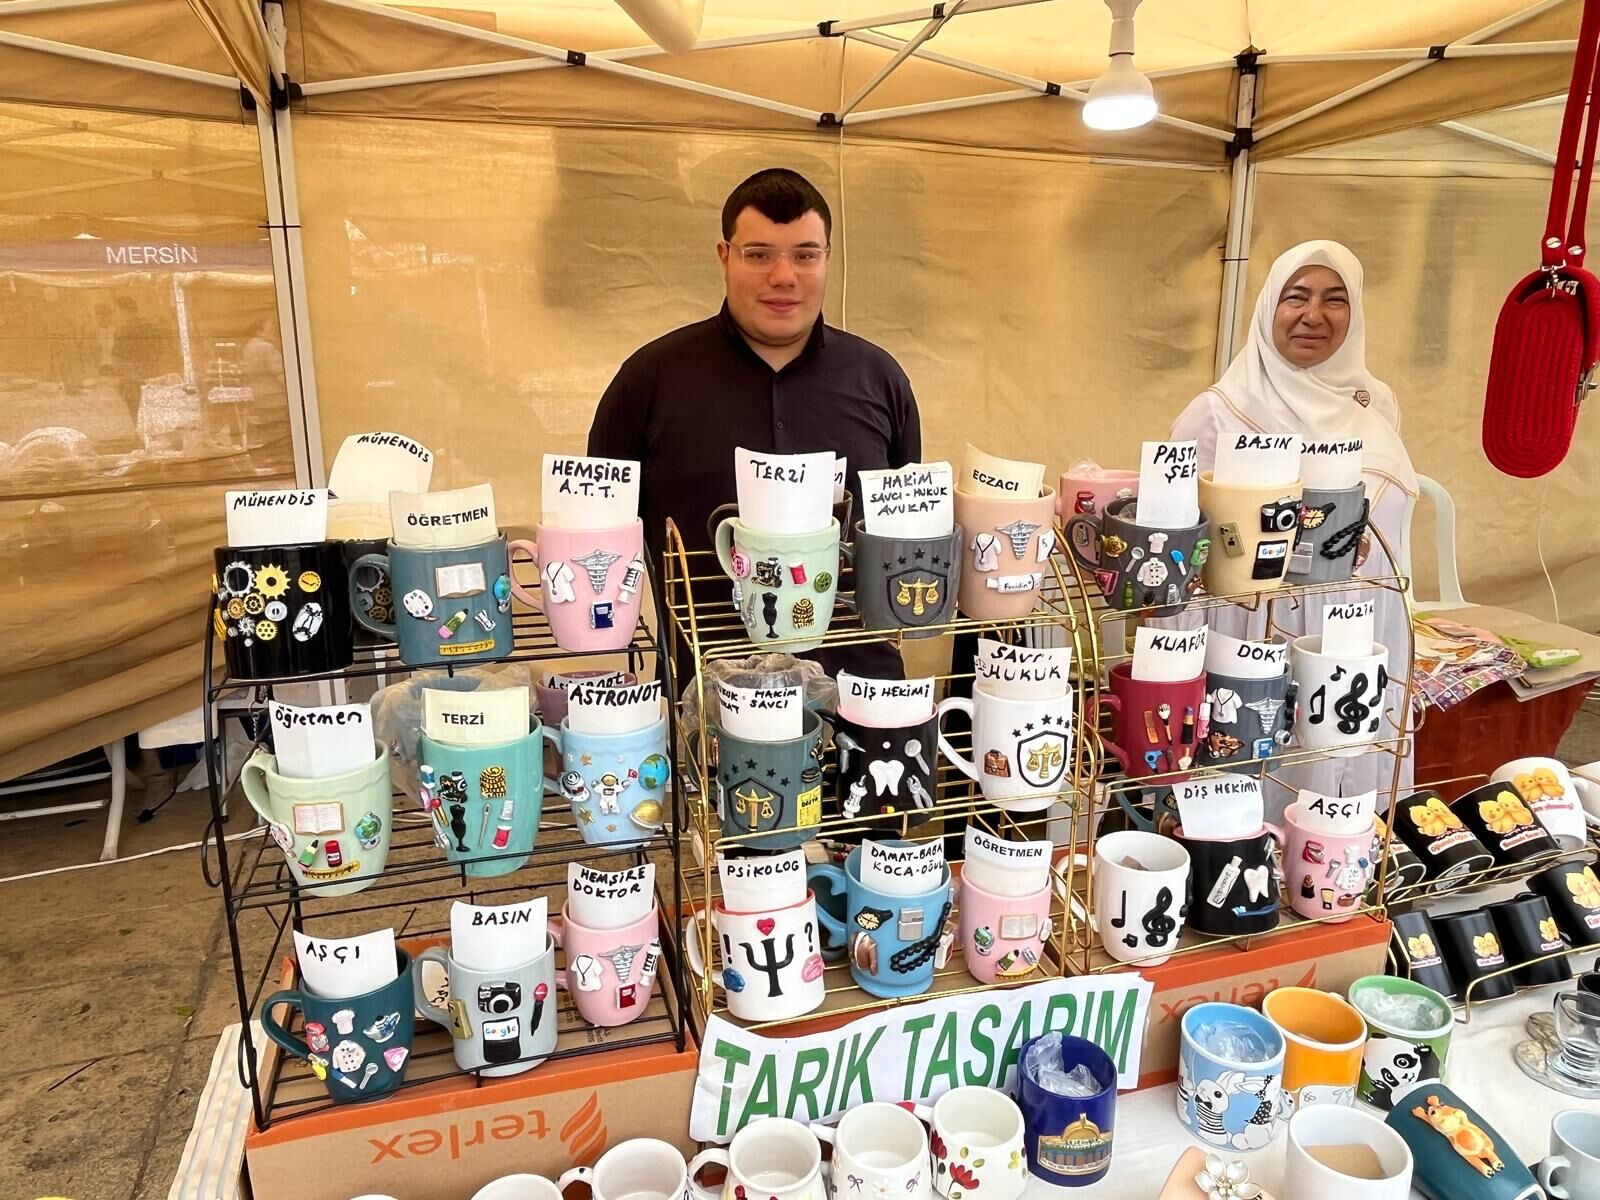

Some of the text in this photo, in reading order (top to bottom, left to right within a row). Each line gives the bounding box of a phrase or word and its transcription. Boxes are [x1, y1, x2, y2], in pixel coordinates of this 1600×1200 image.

[105, 243, 198, 264] MERSİN
[356, 432, 430, 463] MÜHENDİS
[1234, 434, 1293, 450] BASIN
[551, 460, 632, 482] HEMŞİRE
[750, 459, 807, 483] TERZİ
[882, 470, 933, 490] HAKİM
[972, 468, 1020, 492] ECZACI
[559, 480, 615, 498] A.T.T.
[233, 491, 317, 511] MÜHENDİS
[877, 500, 941, 517] AVUKAT
[407, 506, 490, 528] ÖĞRETMEN
[1261, 545, 1286, 557] Gogle
[1327, 604, 1374, 620] MÜZİK
[1237, 643, 1287, 663] DOKT
[983, 663, 1061, 682] HUKUK
[569, 683, 661, 707] ASTRONOT
[850, 681, 931, 701] DİŞ HEKİMİ
[749, 699, 789, 710] SAVCI
[275, 705, 362, 729] Öğretmen
[441, 711, 485, 726] TERZİ
[1183, 784, 1209, 799] DİŞ
[1308, 798, 1361, 819] AŞÇI
[974, 835, 1043, 858] ÖĞRETMEN
[580, 866, 647, 887] HEMŞİRE
[727, 859, 801, 878] PSİKOLOG
[573, 878, 641, 899] DOKTOR
[471, 908, 532, 927] BASIN
[305, 940, 361, 964] AŞÇI
[484, 1024, 517, 1038] Gogle
[713, 1024, 888, 1138] TARIK
[902, 987, 1140, 1100] TASARIM
[367, 1109, 552, 1165] terlex
